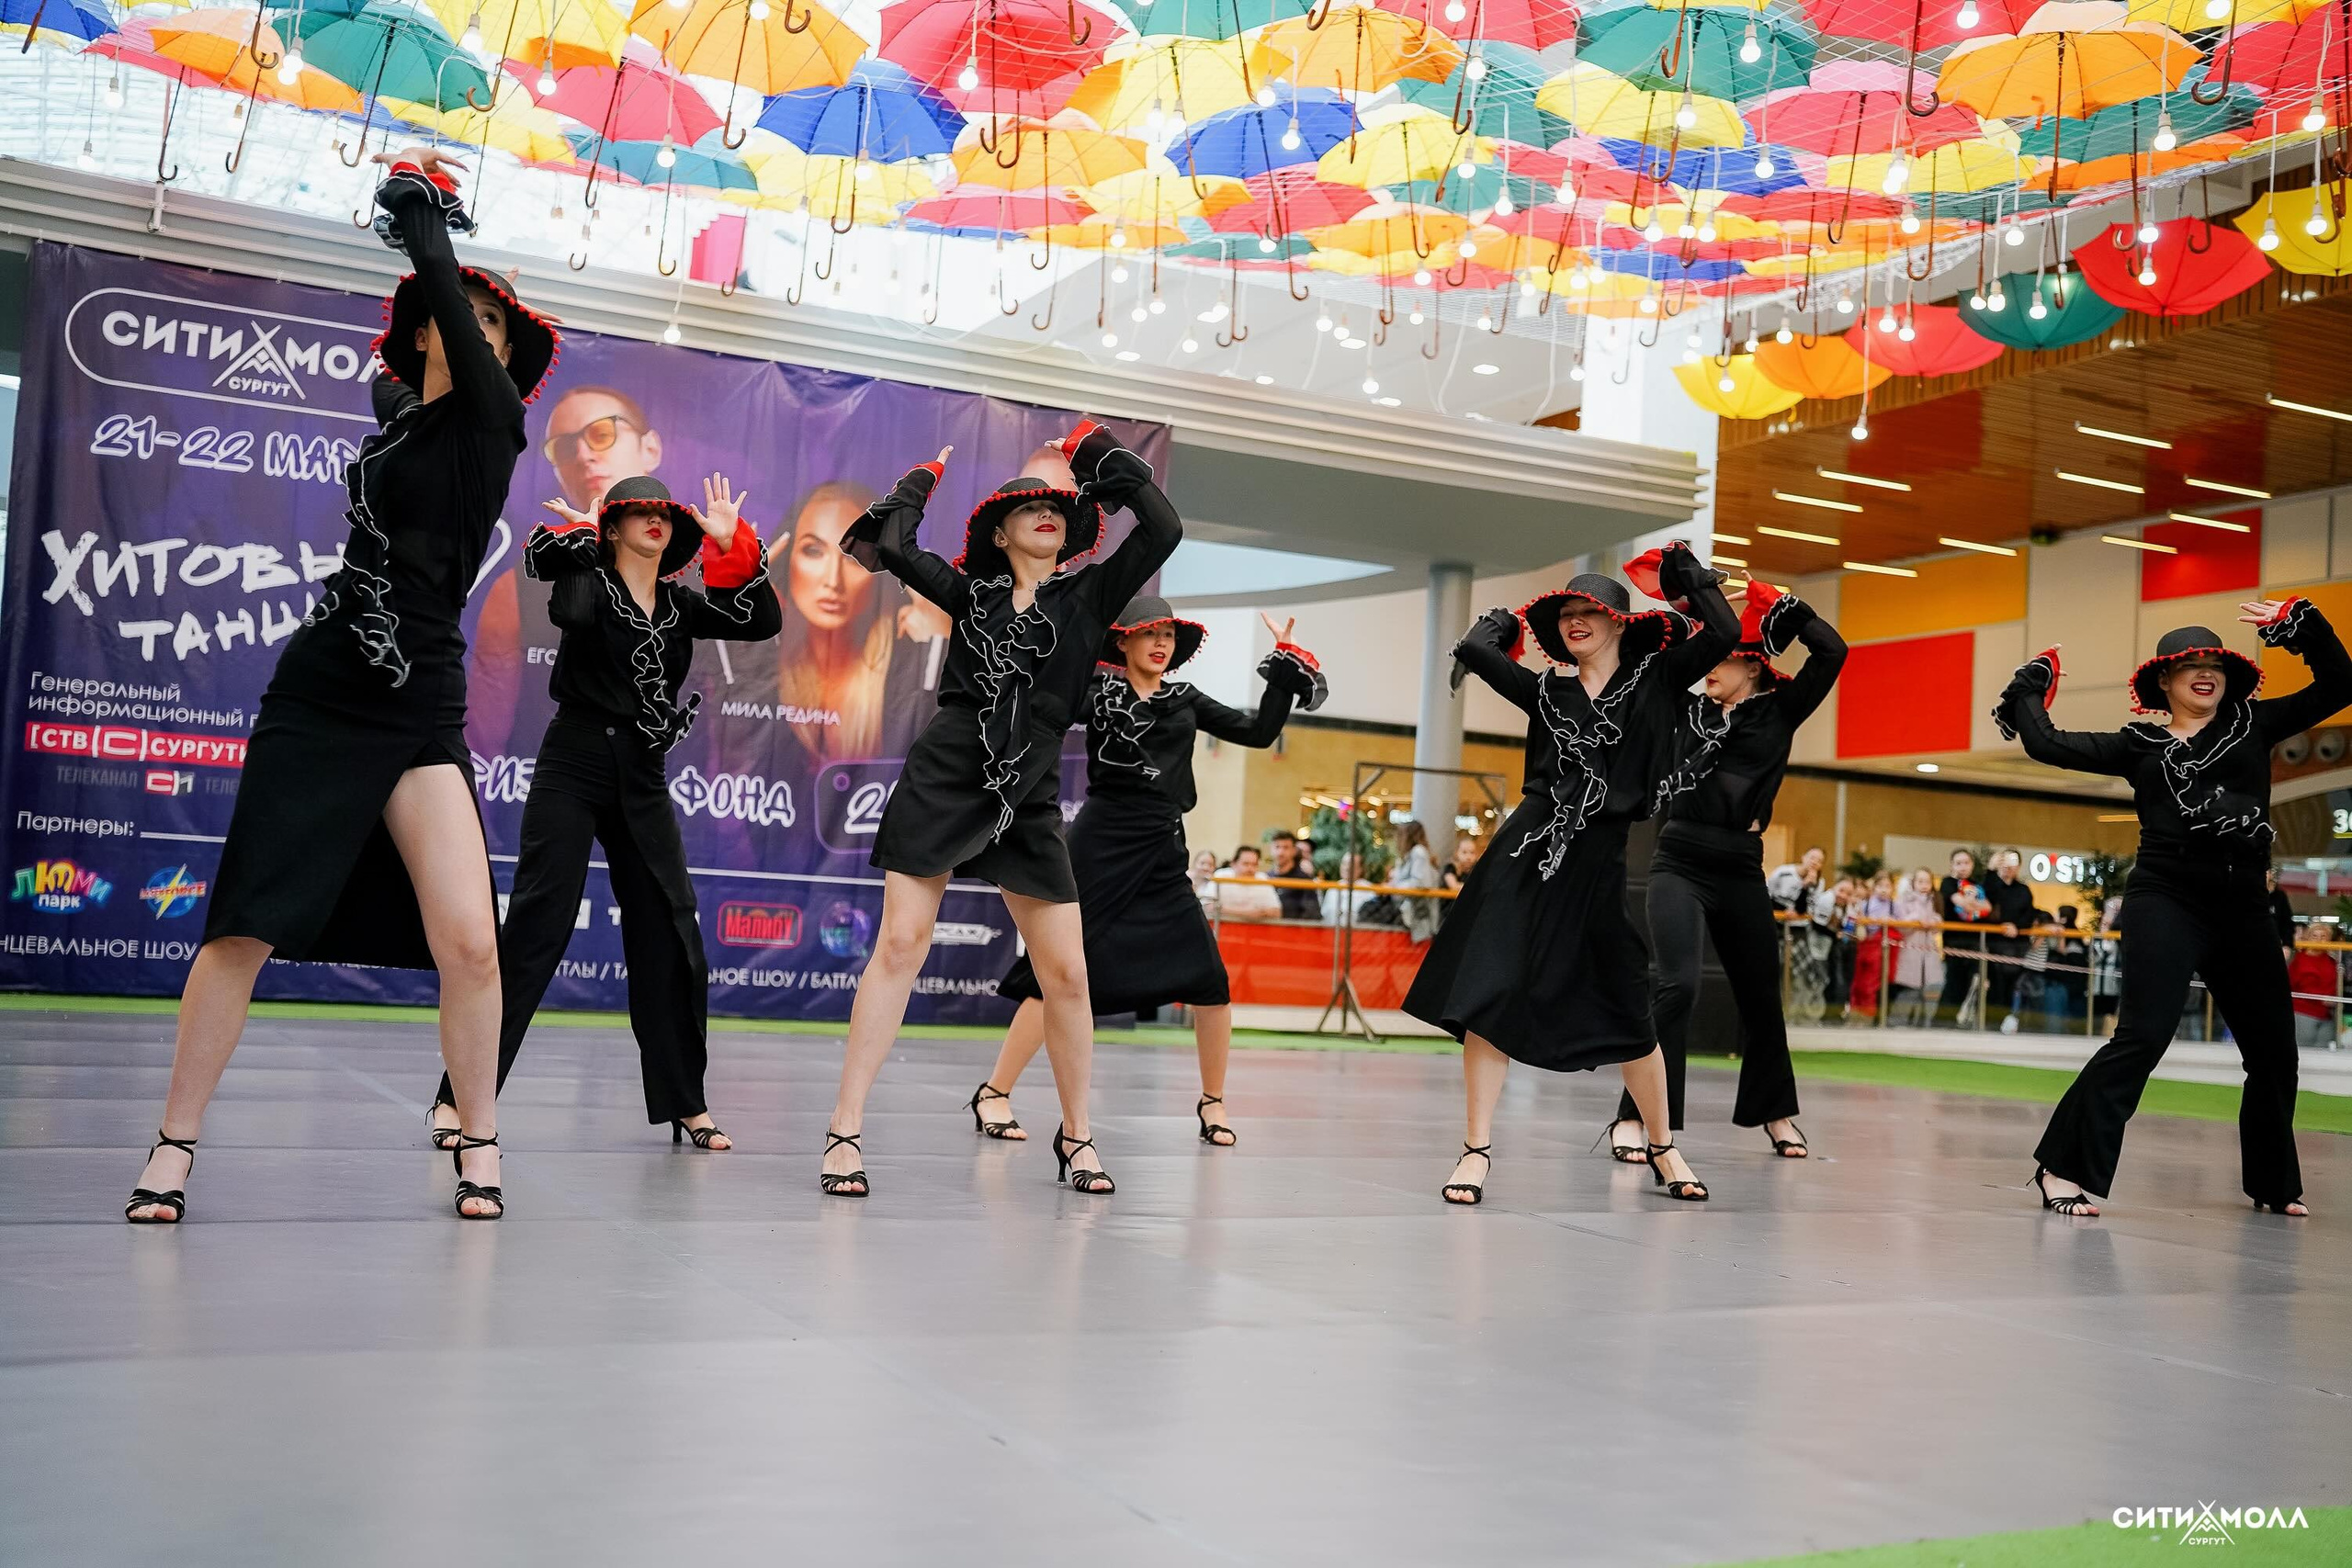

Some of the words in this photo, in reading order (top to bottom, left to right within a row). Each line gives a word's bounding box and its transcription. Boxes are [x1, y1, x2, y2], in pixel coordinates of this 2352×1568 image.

[102, 310, 243, 360] СИТИ
[285, 336, 387, 383] МОЛ
[229, 376, 291, 398] СУРГУТ
[90, 413, 254, 473] 21-22
[264, 431, 358, 485] МАР
[41, 530, 345, 616] ХИТОВЫ
[118, 591, 315, 661] ТАНЦ
[30, 671, 181, 703] Генеральный
[28, 694, 243, 728] информационный
[721, 701, 774, 721] МИЛА
[775, 705, 841, 727] РЕДИНА
[17, 811, 135, 838] Партнеры:
[0, 934, 139, 959] НЦЕВАЛЬНОЕ
[144, 941, 198, 961] ШОУ
[752, 968, 797, 988] ШОУ
[810, 971, 863, 992] БАТТЛ
